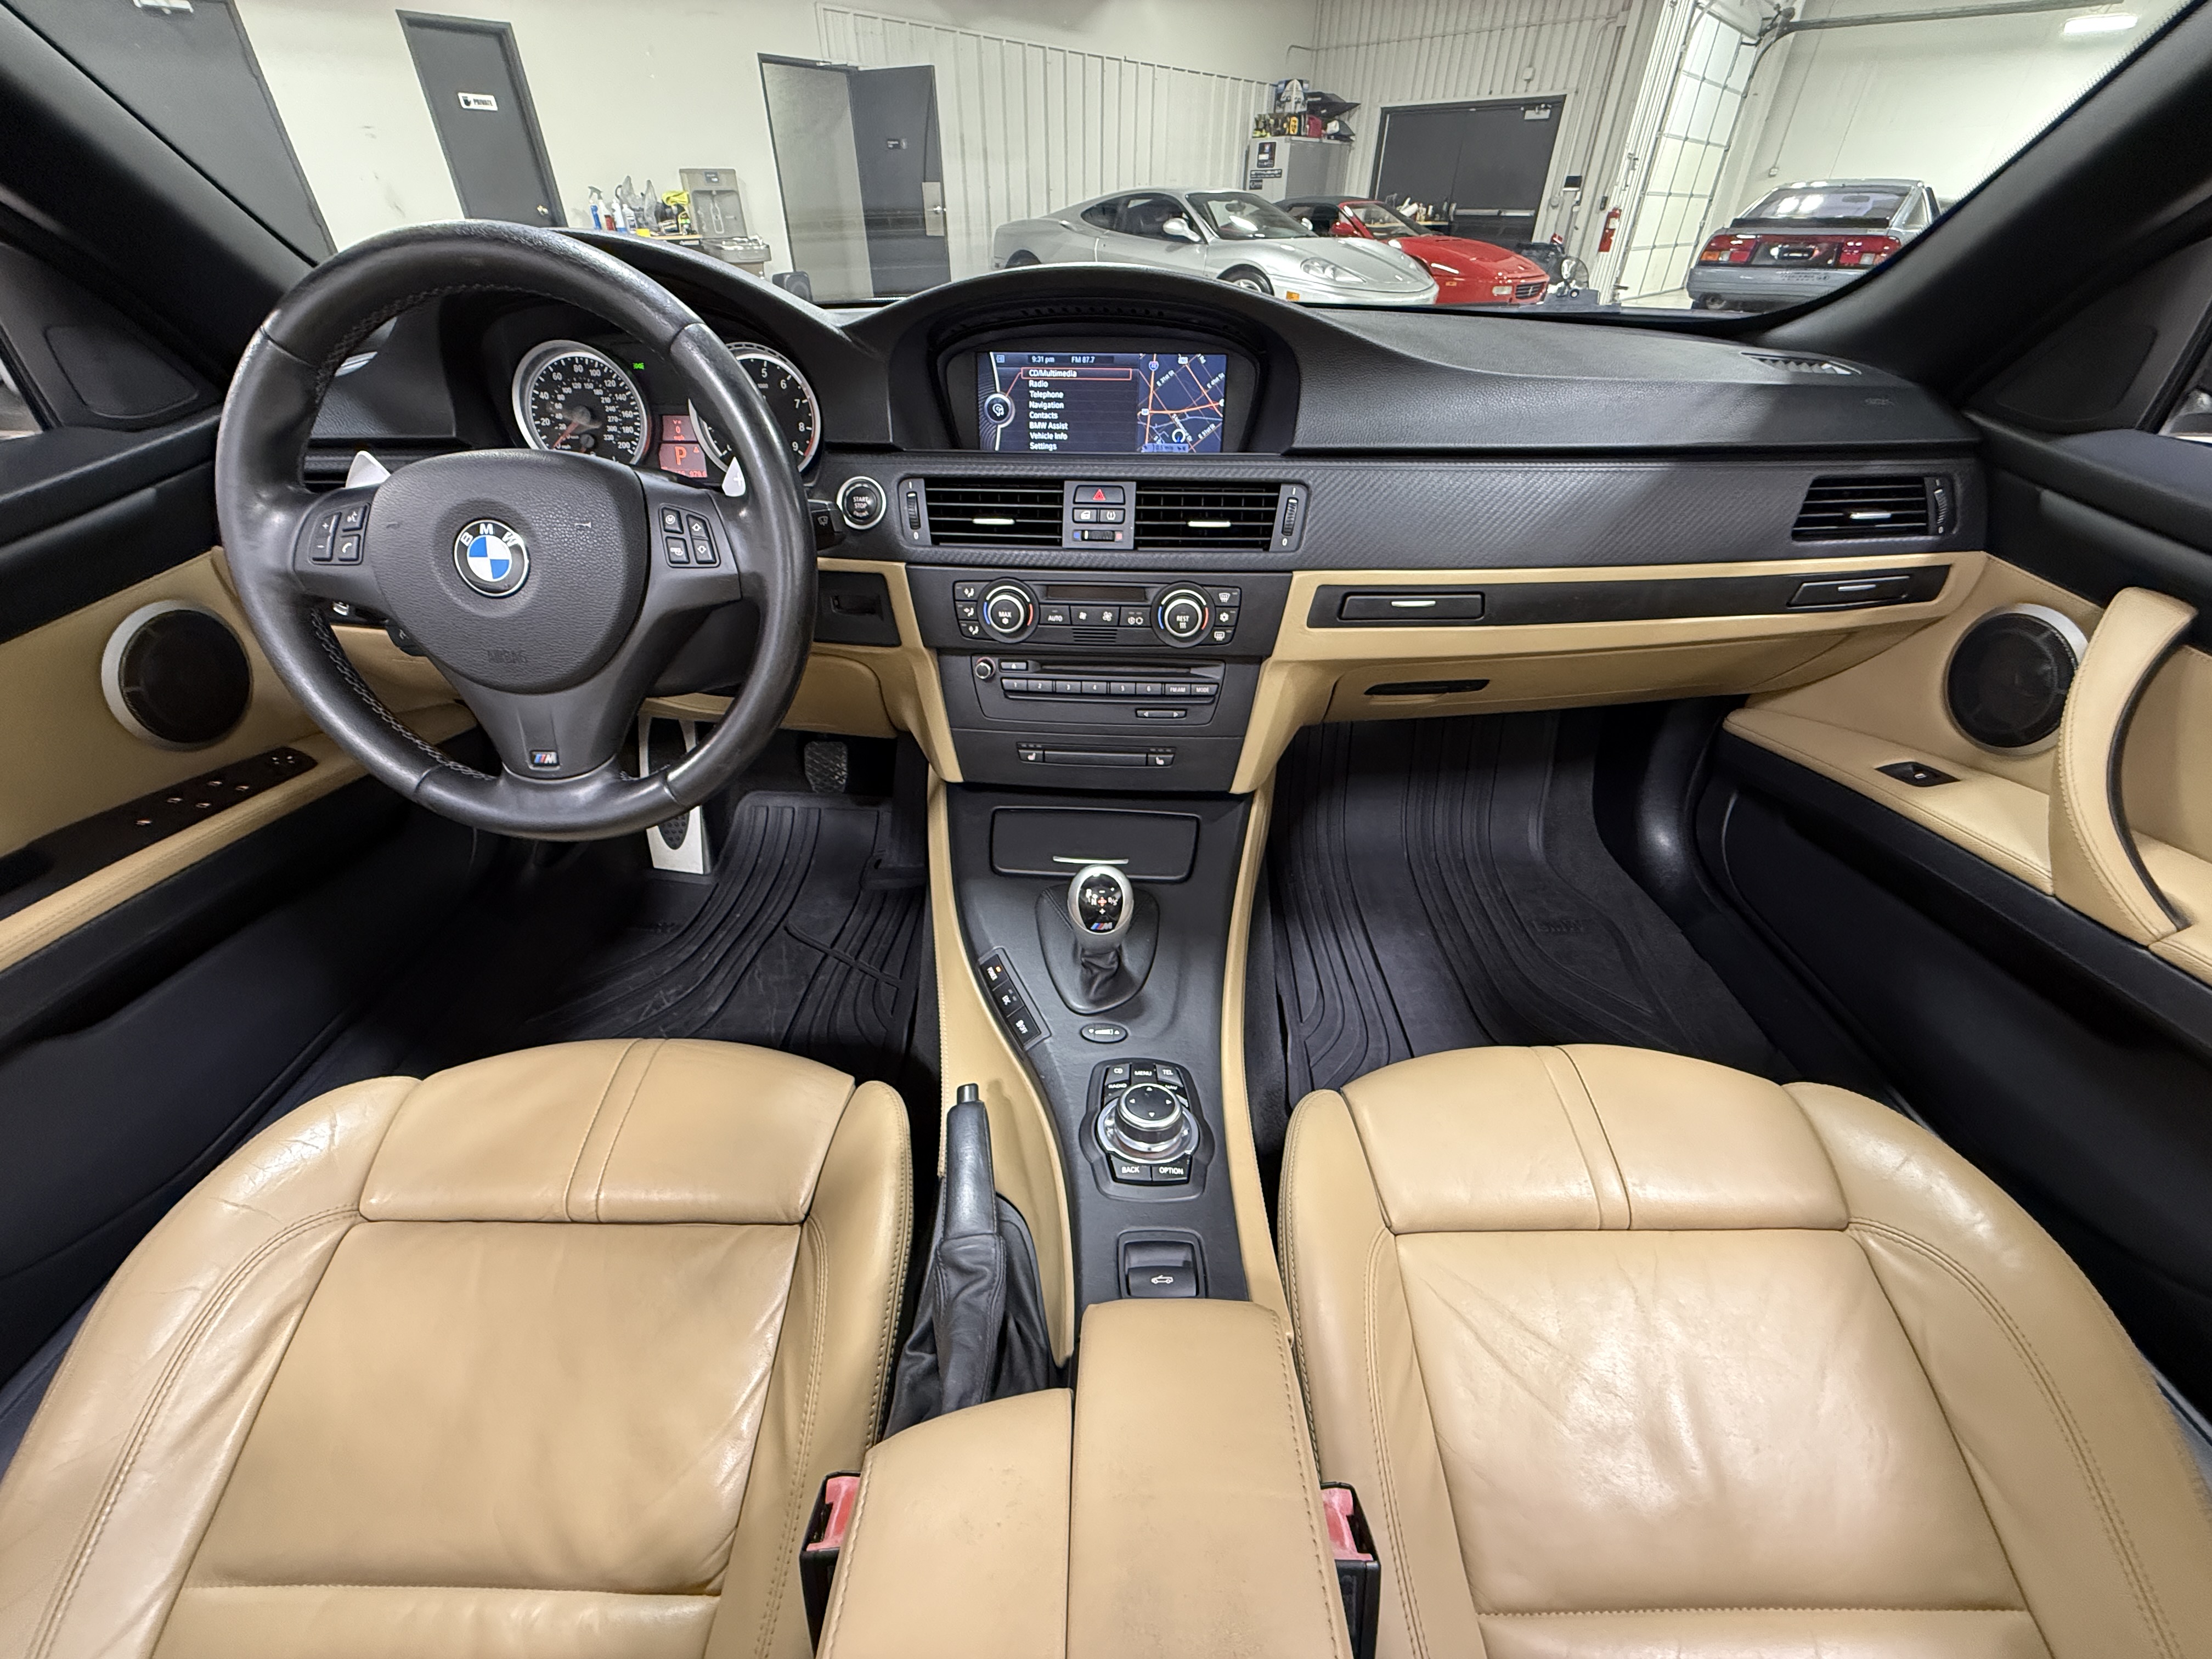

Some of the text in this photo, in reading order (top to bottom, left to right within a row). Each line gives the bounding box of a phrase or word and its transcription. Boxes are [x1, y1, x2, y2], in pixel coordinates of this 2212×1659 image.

[573, 364, 583, 373] 80
[761, 368, 768, 378] 5
[1029, 369, 1077, 377] CD/Multimedia
[780, 380, 787, 389] 6
[1029, 391, 1064, 399] Telephone
[794, 399, 800, 408] 7
[1029, 401, 1064, 409] Navigation
[540, 417, 550, 426] 20
[798, 422, 805, 432] 8
[792, 442, 799, 451] 9
[1030, 442, 1058, 450] Settings
[675, 446, 686, 465] P
[460, 523, 519, 547] BMW
